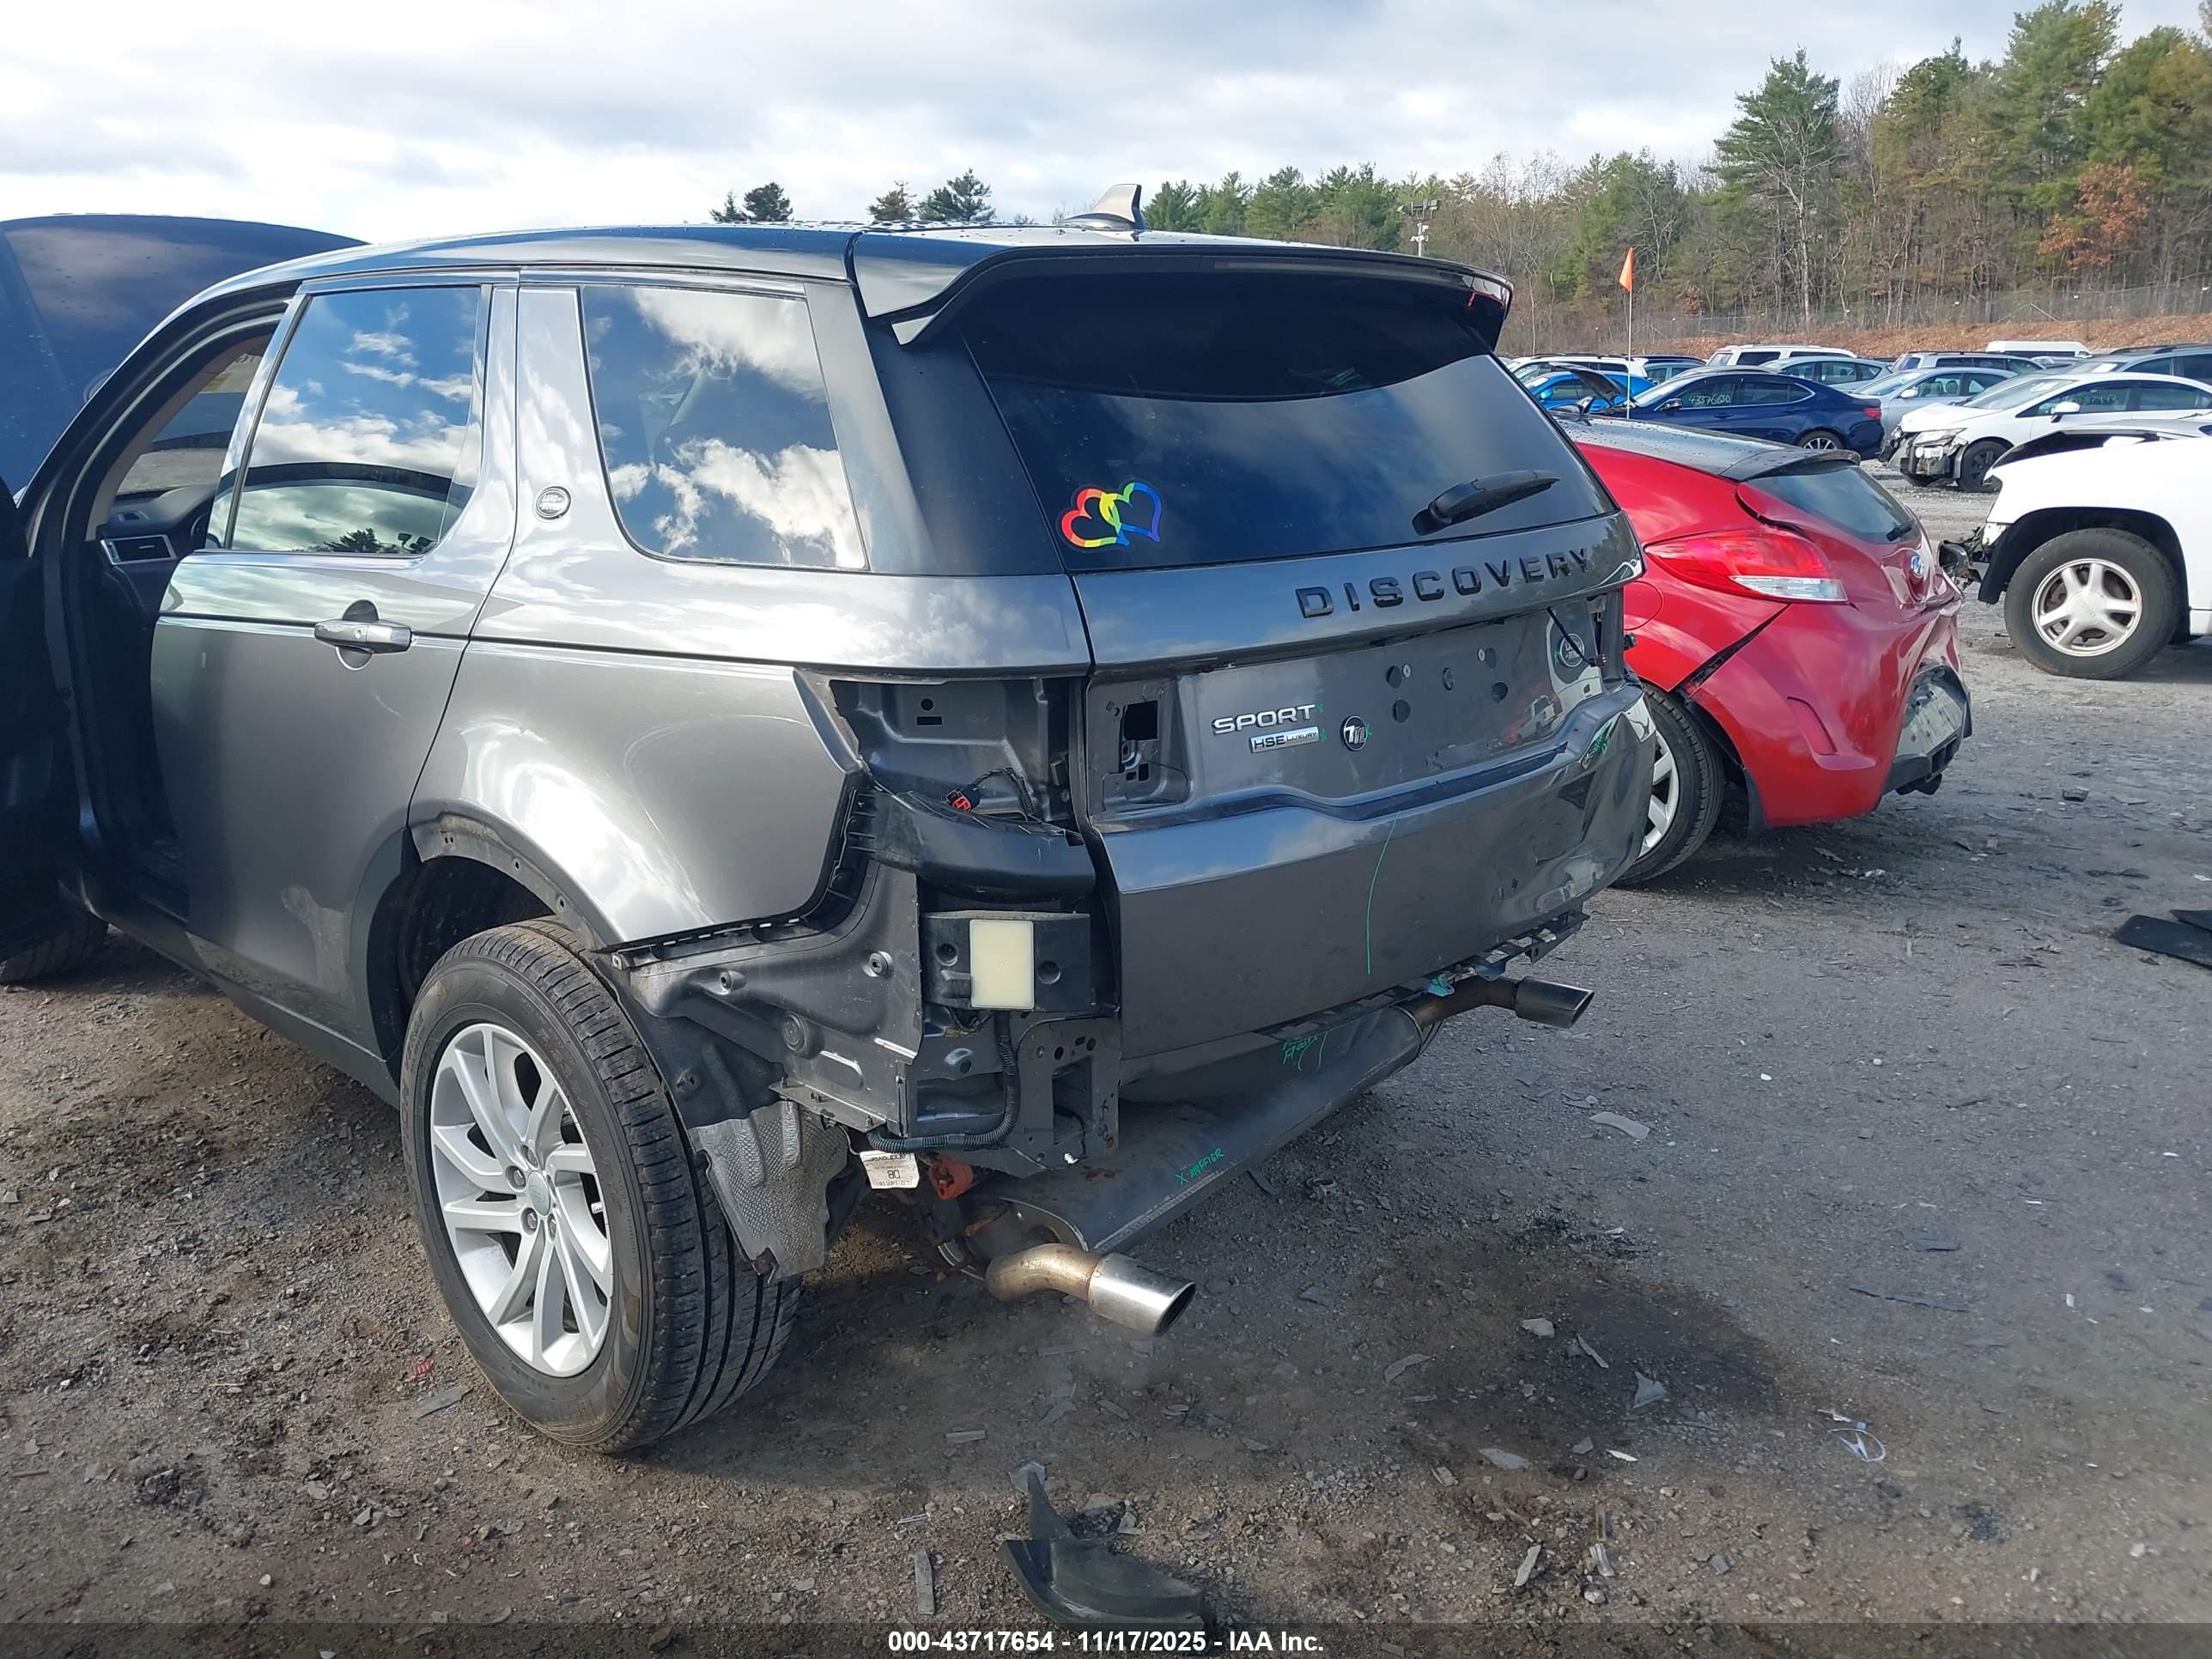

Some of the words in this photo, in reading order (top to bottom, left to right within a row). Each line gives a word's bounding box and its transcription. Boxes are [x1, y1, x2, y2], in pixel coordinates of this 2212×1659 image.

[1295, 548, 1589, 618] DISCOVERY
[1212, 704, 1316, 735] SPORT
[1254, 735, 1285, 750] HSE
[1285, 732, 1317, 742] LUXURY
